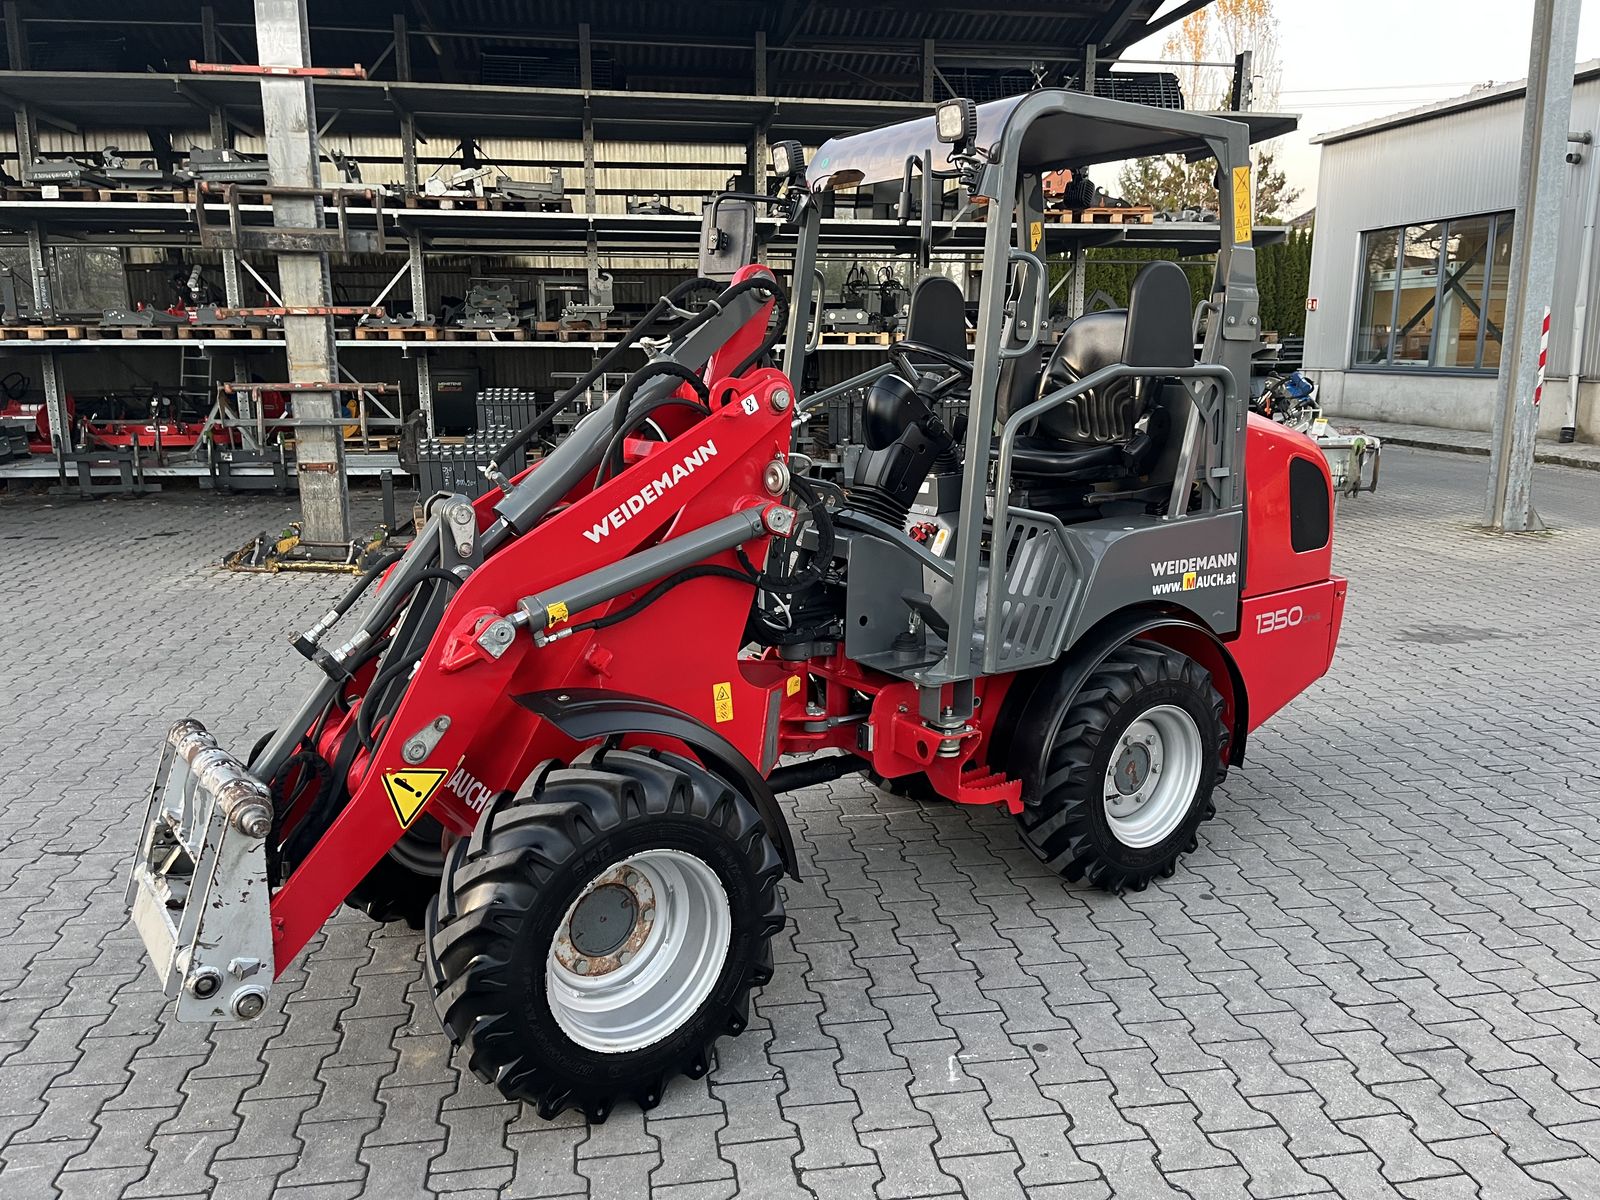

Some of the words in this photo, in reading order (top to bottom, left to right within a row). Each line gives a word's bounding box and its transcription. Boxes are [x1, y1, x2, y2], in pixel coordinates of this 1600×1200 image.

[582, 439, 718, 544] WEIDEMANN
[1151, 553, 1237, 576] WEIDEMANN
[1152, 572, 1236, 595] www.MAUCH.at
[1255, 605, 1303, 635] 1350
[447, 767, 492, 814] AUCH
